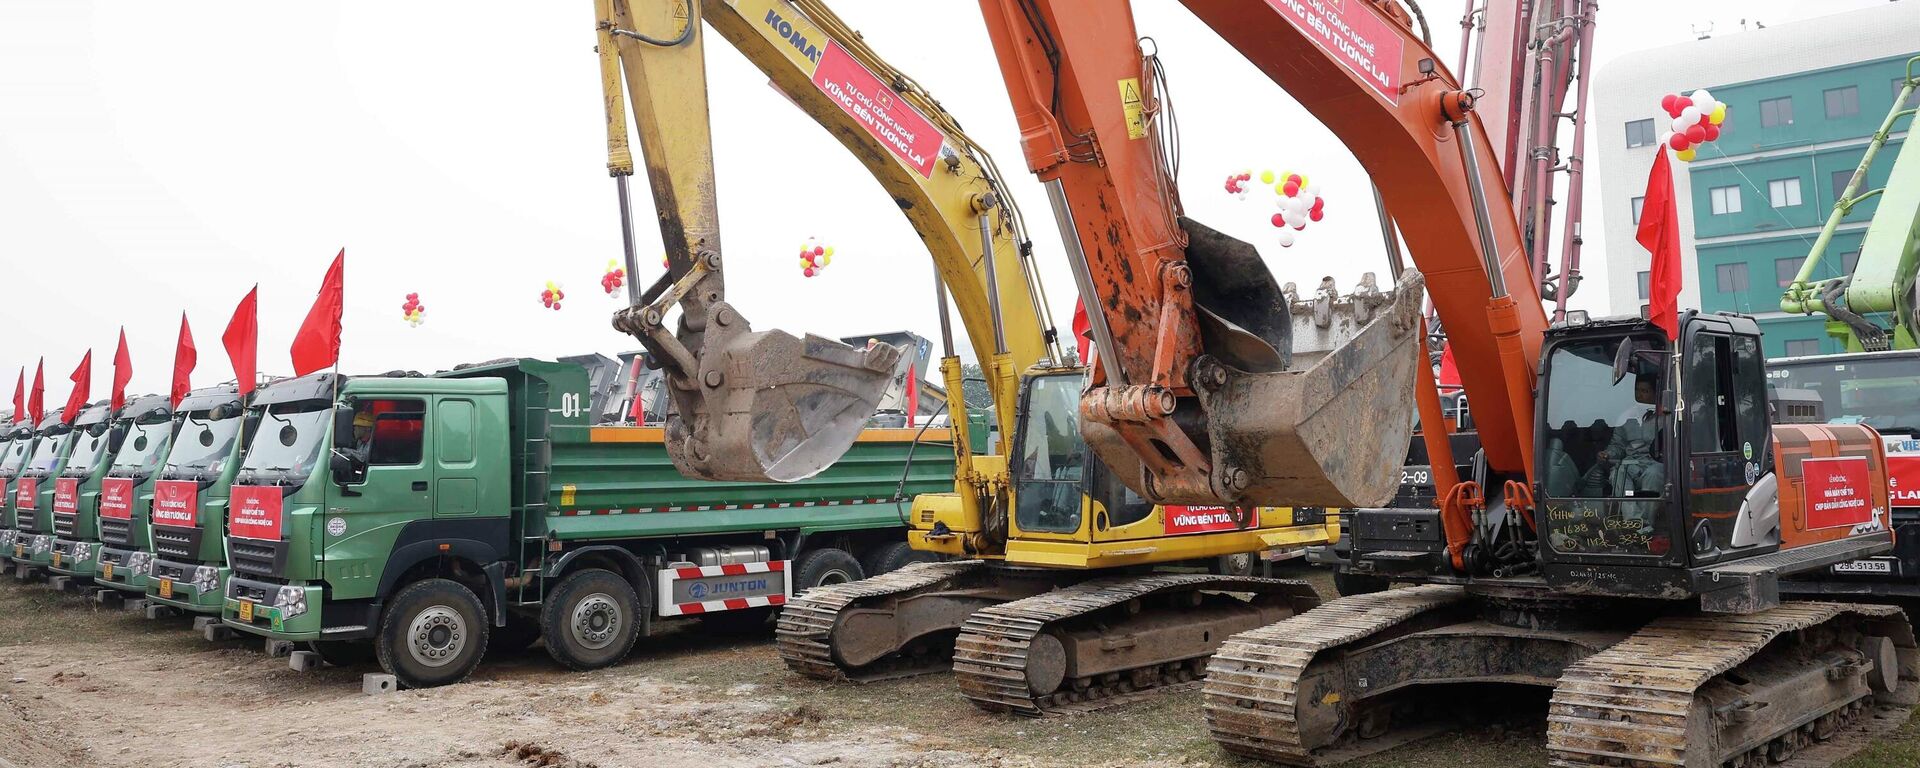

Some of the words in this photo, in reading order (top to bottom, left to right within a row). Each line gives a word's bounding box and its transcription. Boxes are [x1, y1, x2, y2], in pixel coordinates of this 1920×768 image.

[1327, 11, 1350, 37] CÔNG
[1351, 31, 1375, 57] NGHỆ
[1332, 32, 1371, 72] TƯƠNG
[1372, 64, 1390, 87] LAI
[873, 105, 894, 126] CÔNG
[875, 120, 909, 153] TƯƠNG
[908, 149, 925, 167] LAI
[562, 392, 580, 418] 01
[1173, 514, 1197, 527] VỮNG
[712, 580, 767, 593] JUNTON
